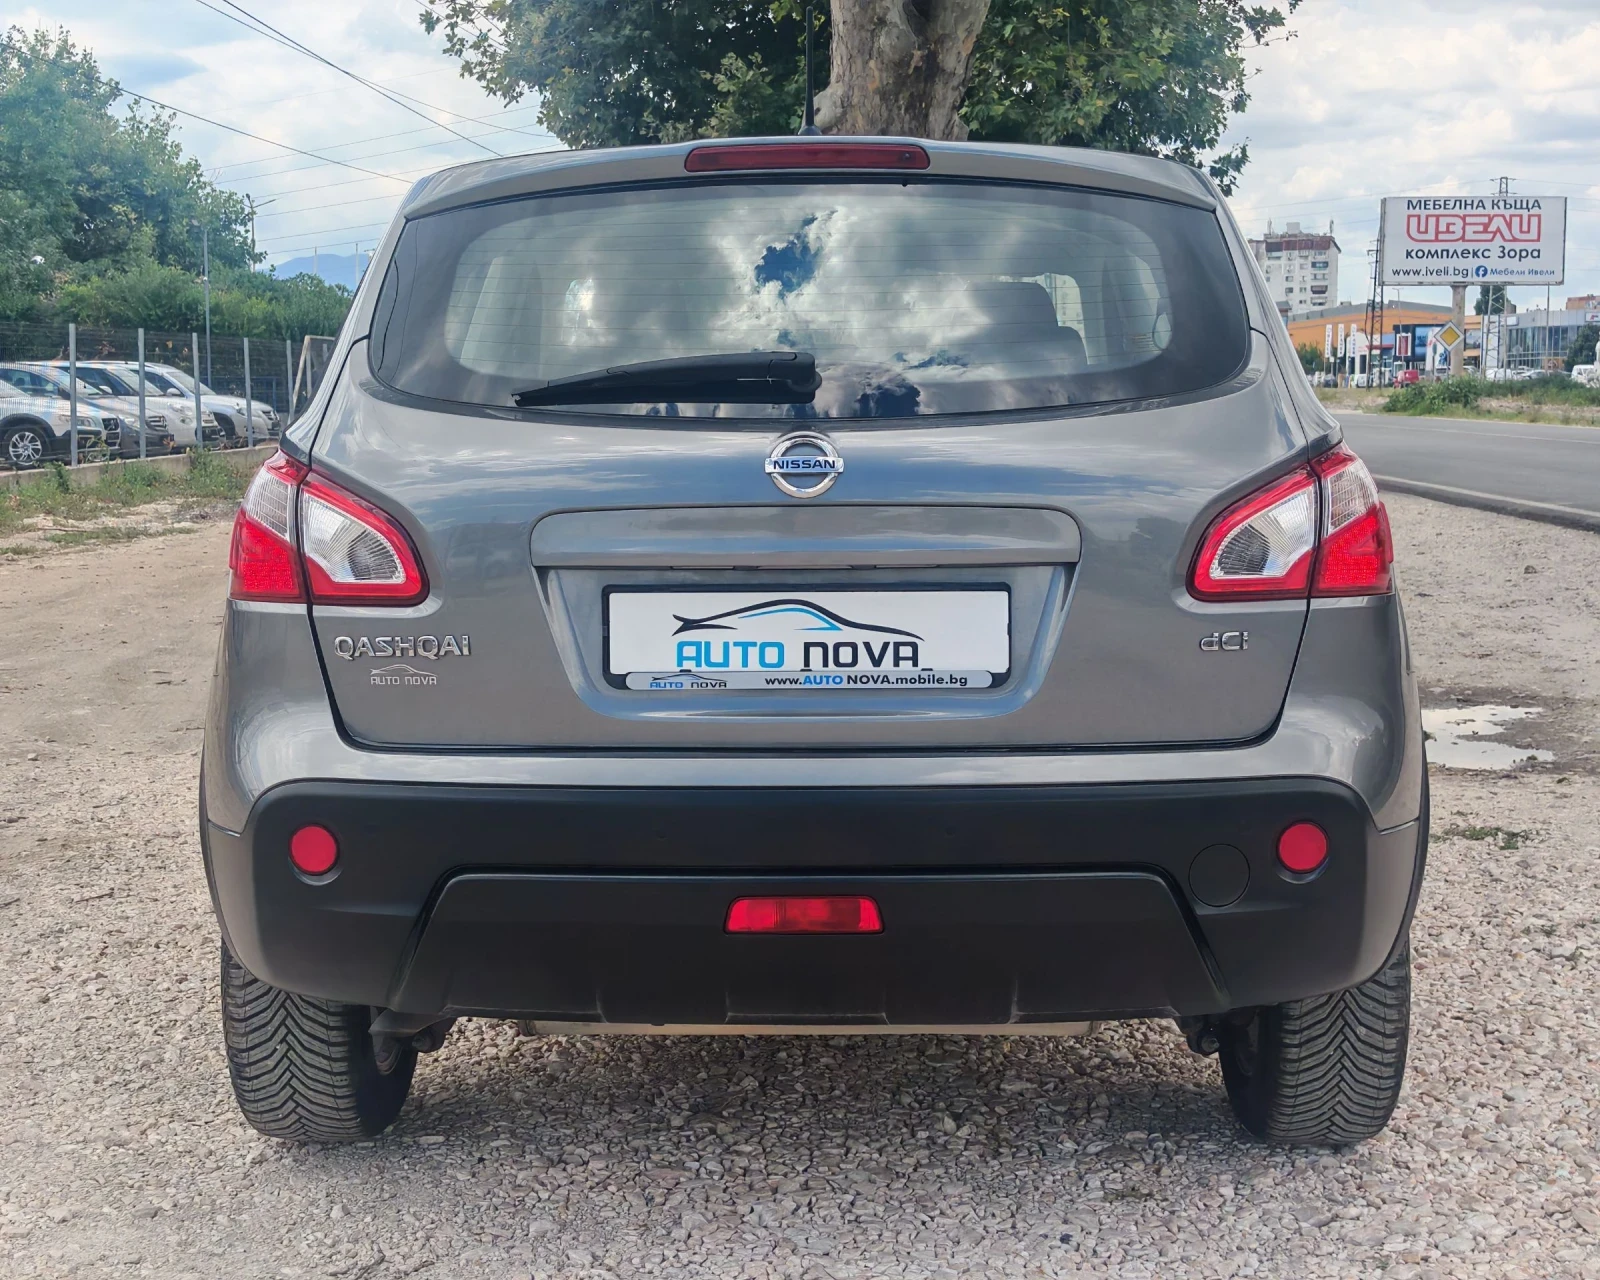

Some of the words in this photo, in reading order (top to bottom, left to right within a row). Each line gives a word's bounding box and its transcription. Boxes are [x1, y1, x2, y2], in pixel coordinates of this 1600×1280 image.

[1406, 199, 1486, 211] МЕБЕЛНА
[1491, 199, 1542, 213] КЪЩА
[1405, 247, 1491, 260] комплекс
[1497, 245, 1541, 262] Зора
[1391, 266, 1469, 279] www.iveli.bg
[1489, 267, 1526, 277] Мебели
[1527, 267, 1555, 277] Ивели
[773, 459, 836, 470] NISSAN
[334, 635, 471, 661] QASHQAI
[676, 641, 785, 668] AUTO
[803, 641, 918, 668] NOVA
[370, 676, 400, 685] AUTO
[405, 676, 437, 685] NOVA
[649, 681, 683, 689] AUTO
[690, 681, 727, 689] NOVA
[846, 675, 968, 688] NOVA.mobile.bg
